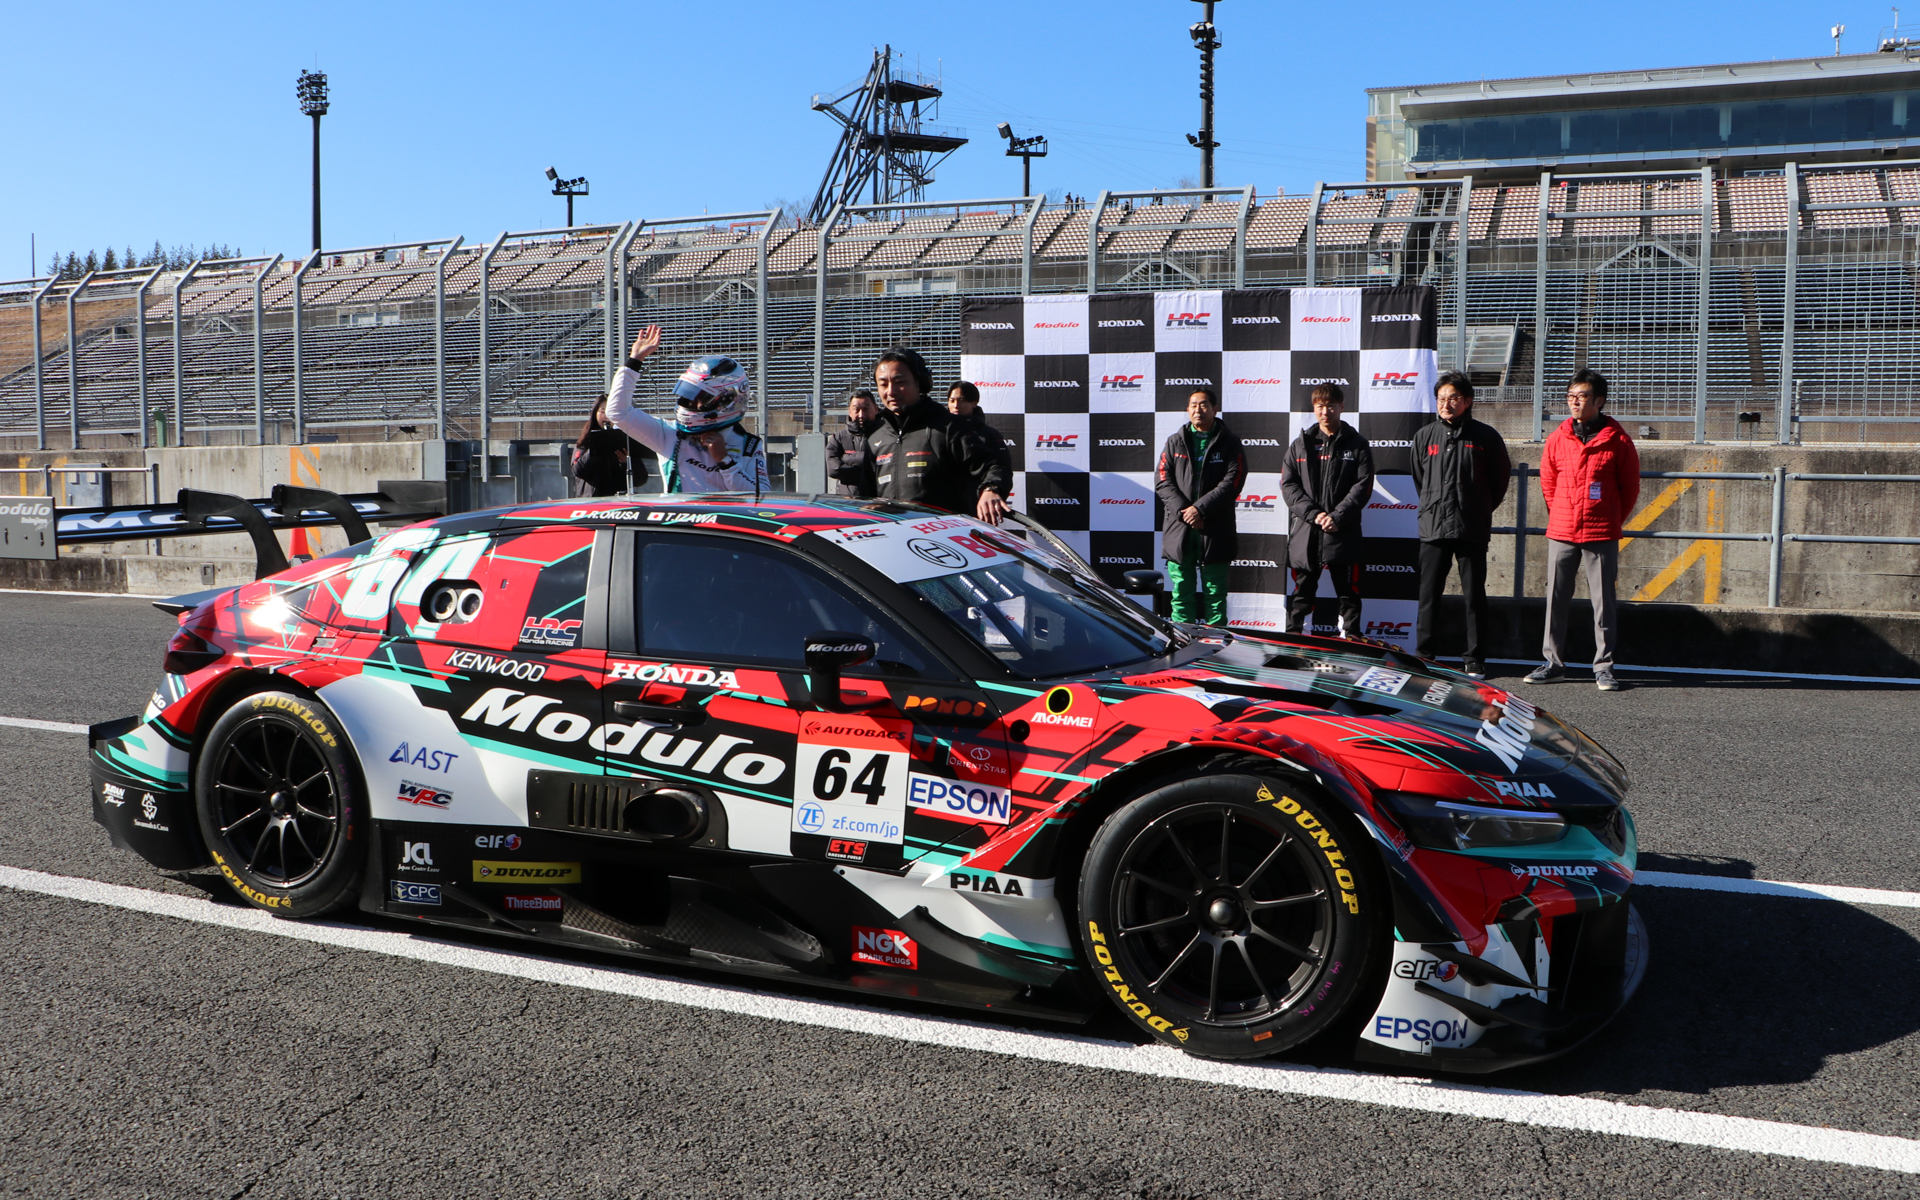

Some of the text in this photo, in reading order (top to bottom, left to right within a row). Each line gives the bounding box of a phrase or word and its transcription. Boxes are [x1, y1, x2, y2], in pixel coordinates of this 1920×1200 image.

[1033, 321, 1080, 329] Modulo
[1097, 319, 1146, 328] HONDA
[1165, 312, 1211, 327] HRC
[1231, 316, 1281, 325] HONDA
[1370, 313, 1422, 323] HONDA
[970, 322, 1015, 330] HONDA
[1033, 380, 1080, 389] HONDA
[1100, 374, 1145, 389] HRC
[1164, 378, 1213, 386] HONDA
[1371, 372, 1419, 387] HRC
[1036, 434, 1079, 448] HRC
[1098, 438, 1146, 447] HONDA
[1035, 497, 1080, 505] HONDA
[1367, 502, 1418, 510] Modulo
[0, 503, 51, 516] odulo
[587, 510, 718, 524] R.OKUSA T.IZAWA
[842, 528, 887, 542] HRC
[1099, 556, 1145, 565] HONDA
[1230, 559, 1278, 568] HONDA
[1365, 564, 1416, 573] HONDA
[519, 616, 583, 642] HRC
[1228, 619, 1277, 628] Modulo
[1364, 620, 1413, 636] HRC
[806, 642, 868, 653] Modulo
[445, 649, 546, 683] KENWOOD
[606, 662, 740, 689] HONDA
[904, 695, 987, 717] PONOS
[262, 695, 337, 748] DUNLOP
[460, 687, 787, 785] Modulo
[822, 725, 907, 741] AUTOBACS
[410, 746, 459, 774] AST
[812, 748, 891, 805] 64
[399, 783, 453, 804] WPC
[1494, 780, 1557, 799] PIAA
[909, 777, 1010, 819] EPSON
[800, 807, 824, 828] ZF
[832, 816, 899, 838] zf.com/jp
[474, 834, 505, 849] elf
[829, 839, 866, 856] ETS
[402, 841, 434, 866] JCL
[1272, 795, 1360, 915] DUNLOP
[397, 864, 411, 872] Japan
[493, 867, 572, 878] DUNLOP
[1527, 864, 1599, 877] DUNLOP
[212, 850, 281, 908] DUNLOP
[949, 872, 1024, 897] PIAA
[408, 885, 439, 899] CPC
[505, 896, 562, 910] ThreeBond
[858, 930, 911, 956] NGK
[858, 952, 911, 966] SPARK PLUGS
[1088, 920, 1174, 1034] DUNLOP
[1394, 959, 1438, 981] elf
[1375, 1015, 1469, 1043] EPSON
